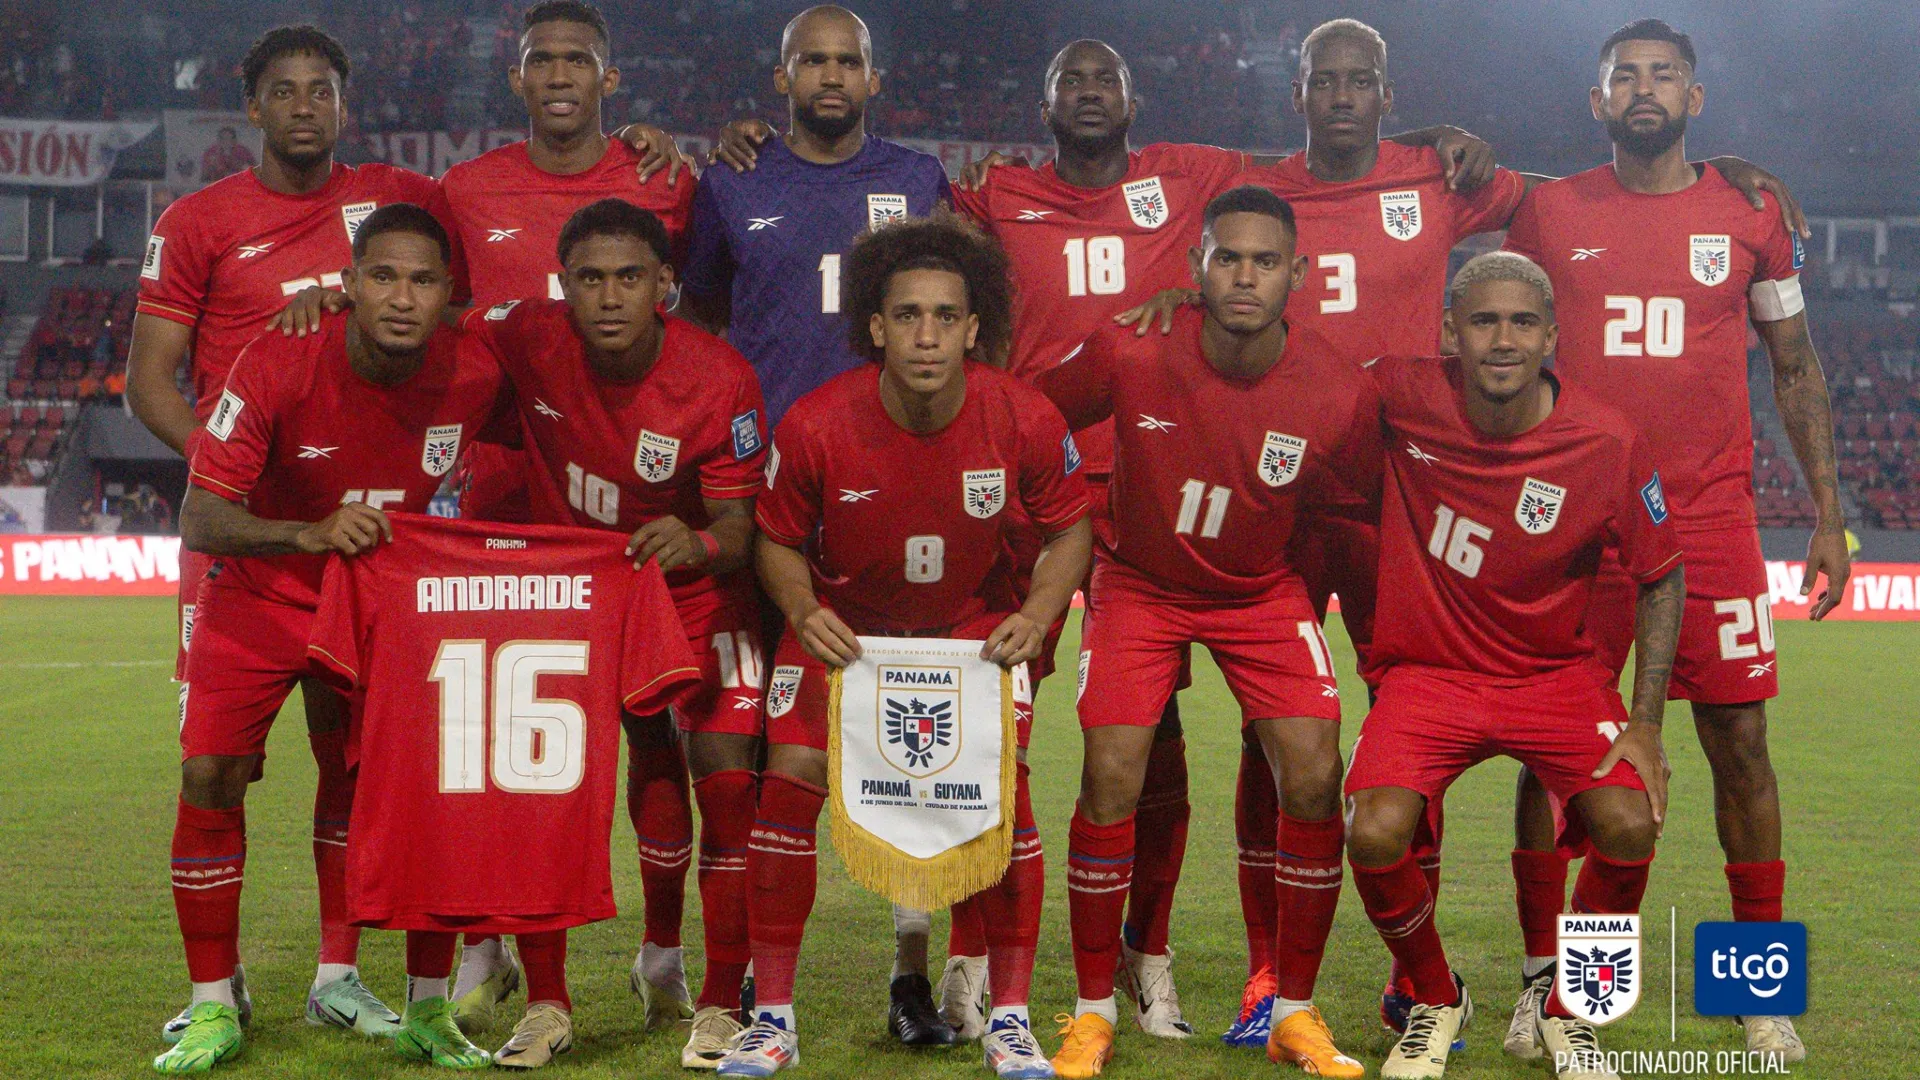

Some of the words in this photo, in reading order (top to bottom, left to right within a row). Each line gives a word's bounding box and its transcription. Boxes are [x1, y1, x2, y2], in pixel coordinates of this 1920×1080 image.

[818, 253, 841, 314] 1
[1062, 235, 1126, 297] 18
[1317, 253, 1358, 314] 3
[1604, 295, 1685, 358] 20
[565, 460, 620, 525] 10
[1175, 478, 1232, 539] 11
[905, 534, 945, 584] 8
[1428, 503, 1493, 579] 16
[416, 575, 592, 613] ANDRADE
[1853, 574, 1920, 611] ¡VA
[1713, 592, 1775, 661] 20
[886, 670, 953, 685] PANAMÁ
[427, 638, 591, 795] 16
[861, 779, 911, 798] PANAMÁ
[934, 782, 981, 800] GUYANA
